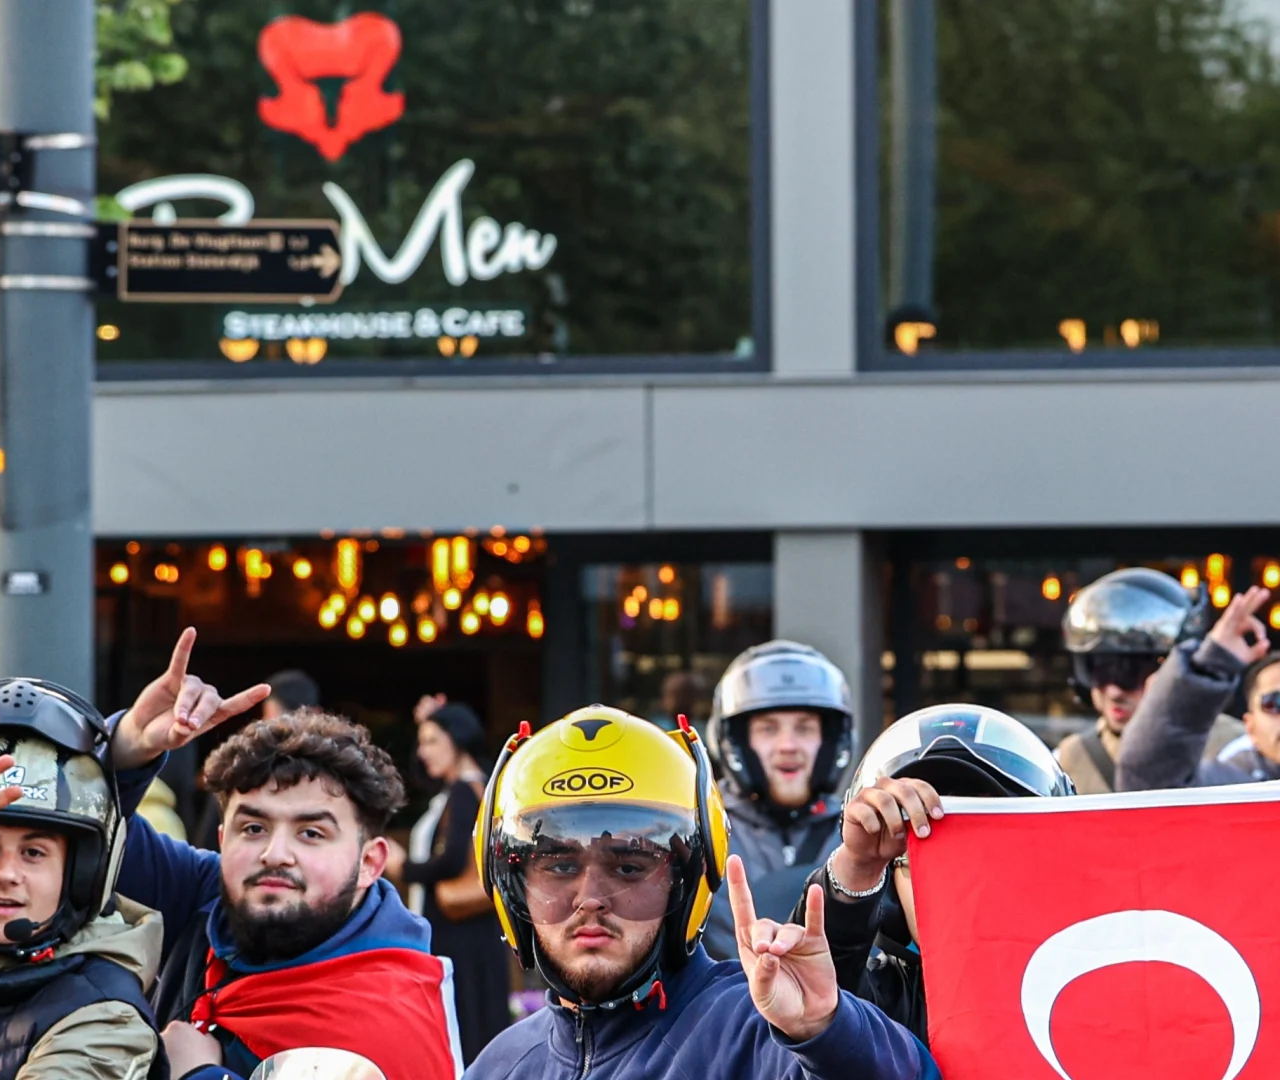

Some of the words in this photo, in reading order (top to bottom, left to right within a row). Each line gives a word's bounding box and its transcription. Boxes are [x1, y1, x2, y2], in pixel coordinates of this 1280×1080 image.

[322, 158, 558, 286] Men
[223, 310, 413, 340] STEAKHOUSE
[413, 307, 441, 338] &
[441, 307, 525, 338] CAFE
[551, 773, 625, 791] ROOF
